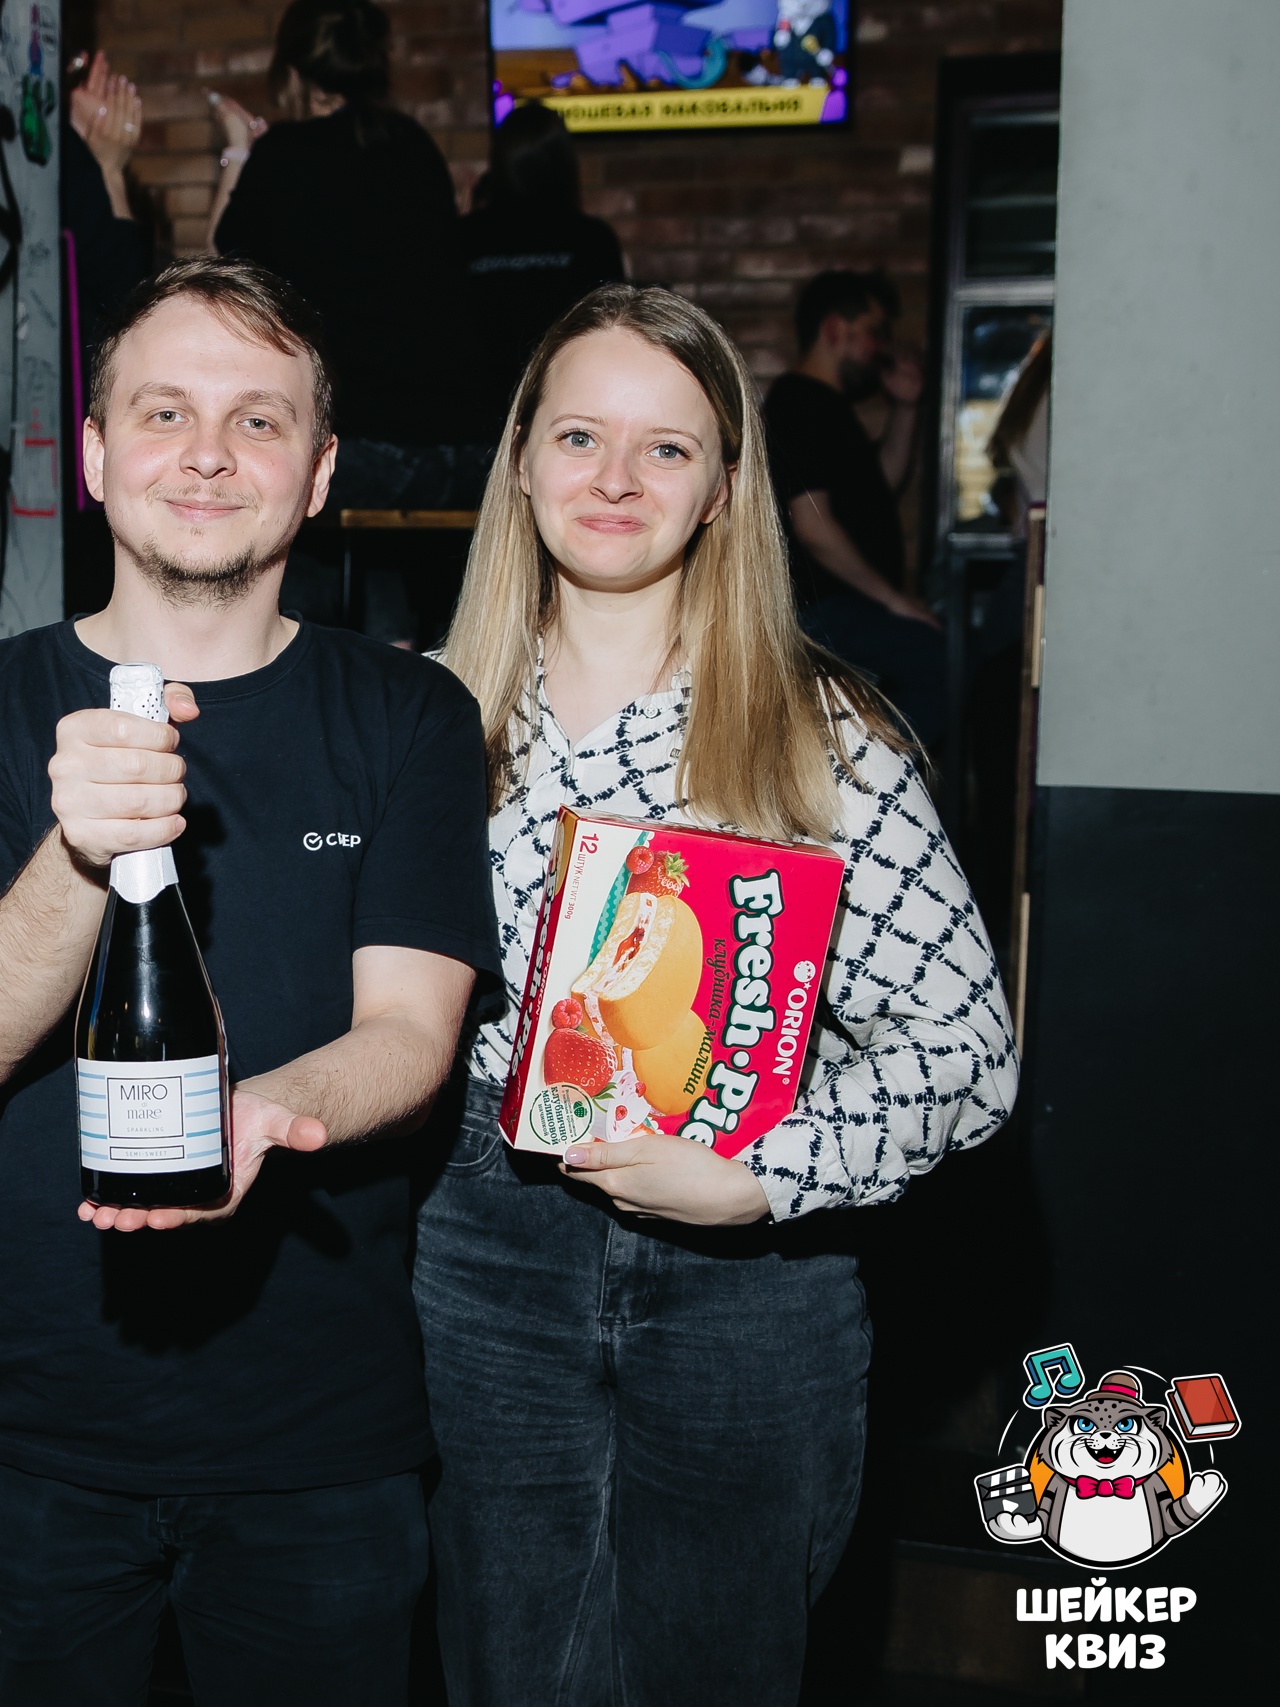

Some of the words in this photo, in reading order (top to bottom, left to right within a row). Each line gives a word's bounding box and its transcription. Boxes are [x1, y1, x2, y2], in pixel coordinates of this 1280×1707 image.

[579, 833, 599, 854] 12
[572, 875, 580, 889] NET
[564, 902, 575, 919] 300g
[724, 869, 783, 1048] Fresh
[683, 938, 727, 1095] клубника-малина
[773, 987, 808, 1076] ORION
[120, 1083, 168, 1100] MIRO
[542, 1089, 561, 1145] малиновой
